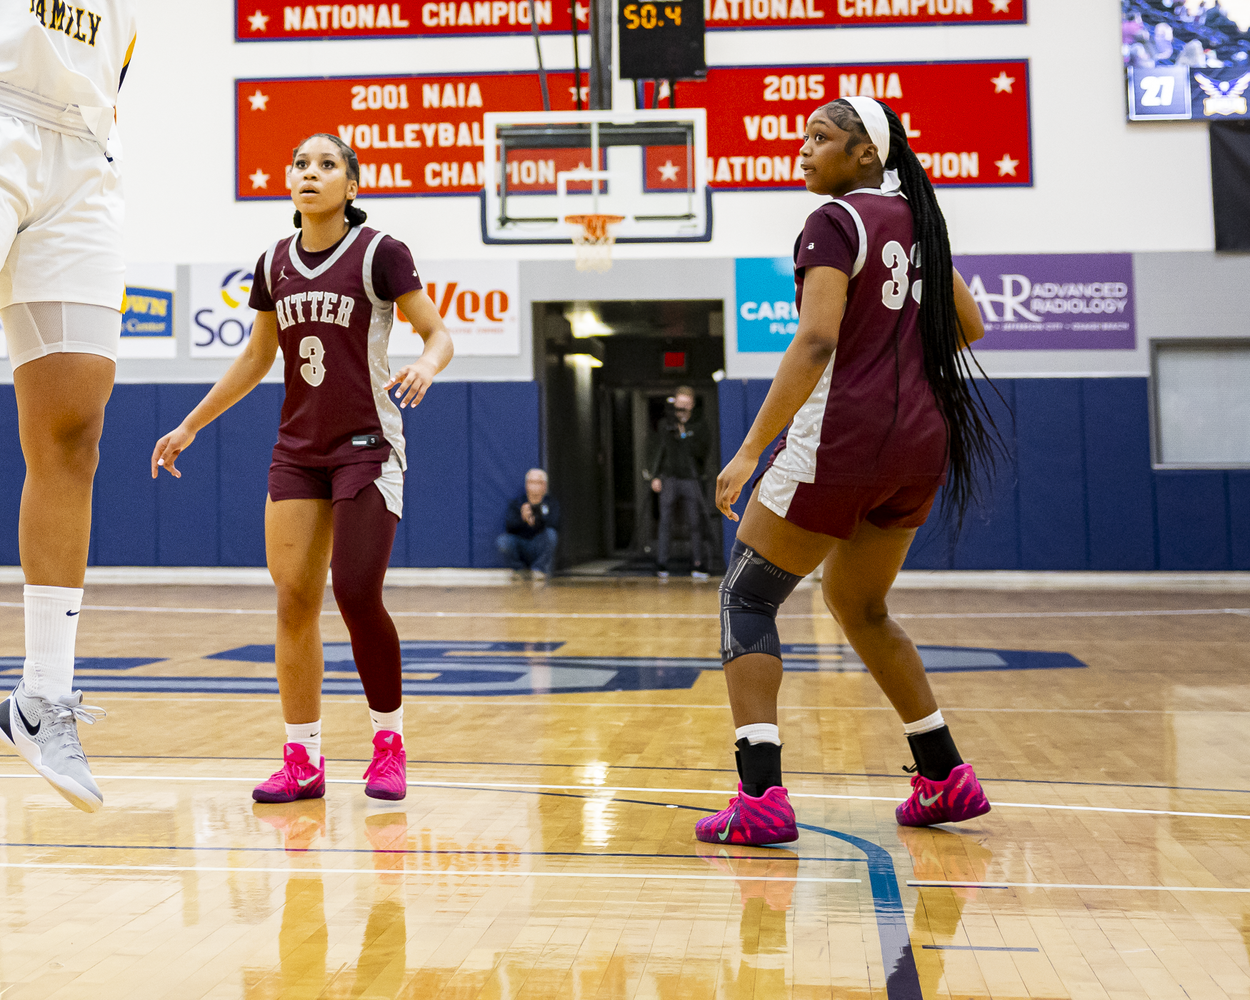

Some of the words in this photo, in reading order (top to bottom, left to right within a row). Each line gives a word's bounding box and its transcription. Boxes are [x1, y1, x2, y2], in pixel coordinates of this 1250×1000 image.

[283, 3, 410, 31] NATIONAL
[421, 0, 553, 27] CHAMPION
[623, 3, 682, 30] 50.4
[351, 84, 409, 110] 2001
[422, 82, 483, 108] NAIA
[763, 74, 825, 101] 2015
[838, 72, 903, 99] NAIA
[337, 121, 502, 149] VOLLEYBAL
[1031, 282, 1128, 298] ADVANCED
[275, 290, 355, 331] RITTER
[1030, 298, 1127, 314] RADIOLOGY
[299, 335, 326, 387] 3
